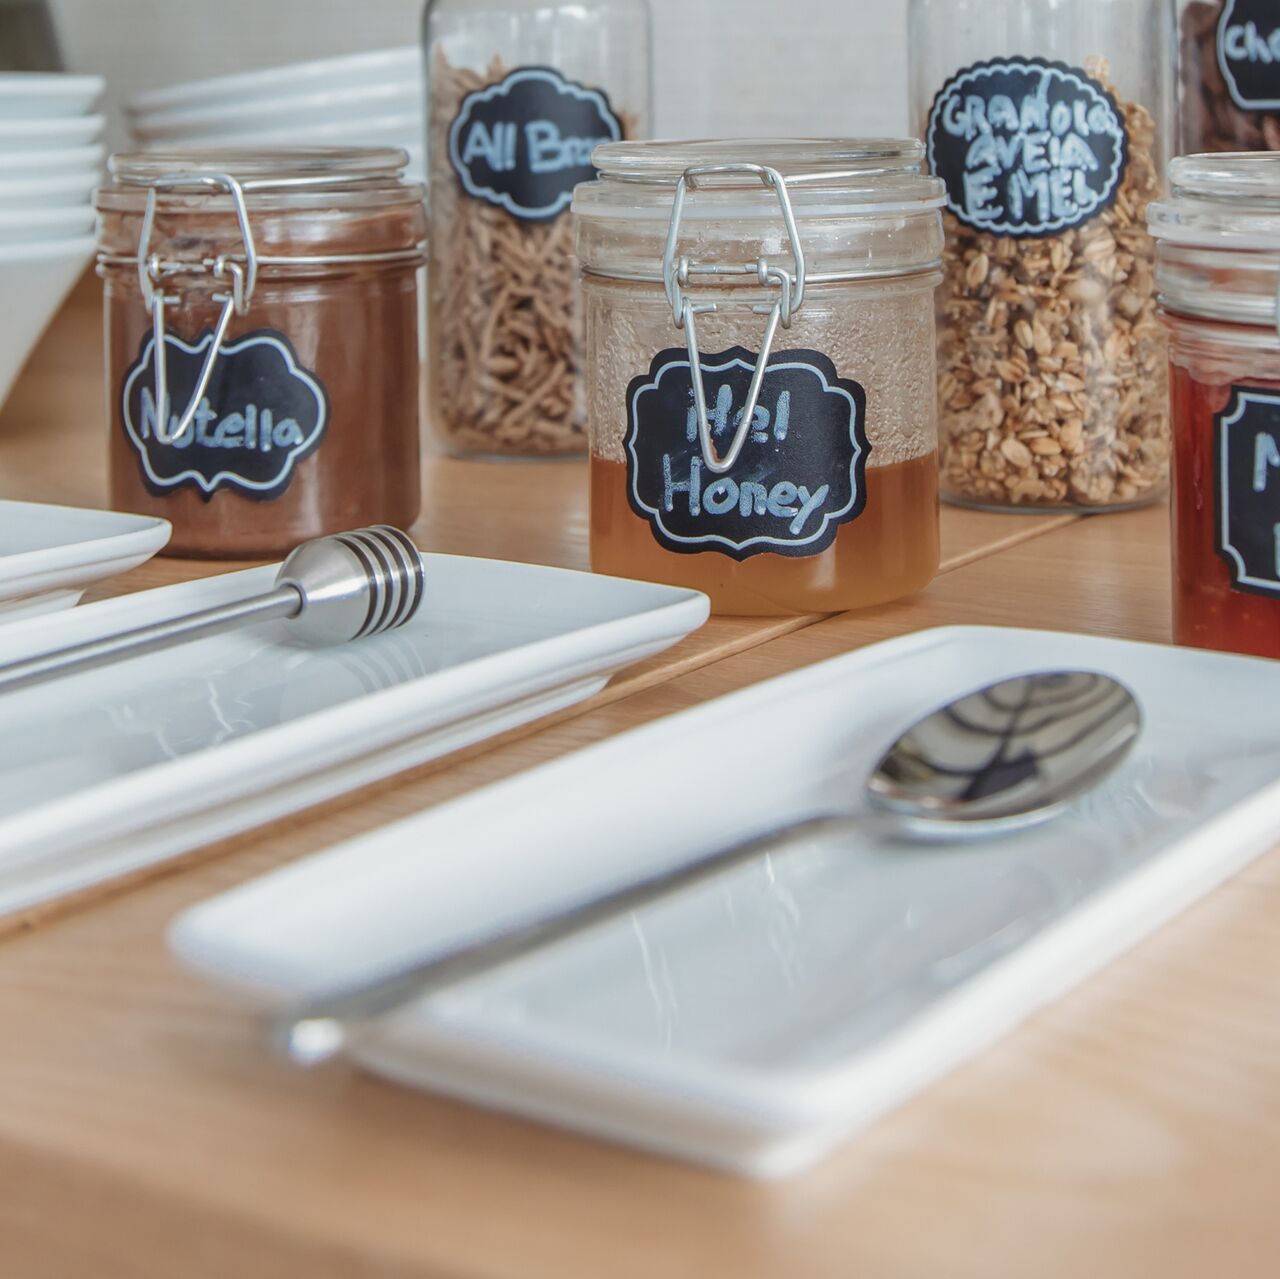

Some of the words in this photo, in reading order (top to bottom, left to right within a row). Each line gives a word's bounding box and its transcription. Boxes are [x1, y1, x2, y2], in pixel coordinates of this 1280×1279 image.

[462, 120, 517, 171] All
[963, 167, 1004, 220] E
[1008, 168, 1098, 221] MEL
[140, 386, 305, 452] Nutella
[662, 453, 830, 535] Honey
